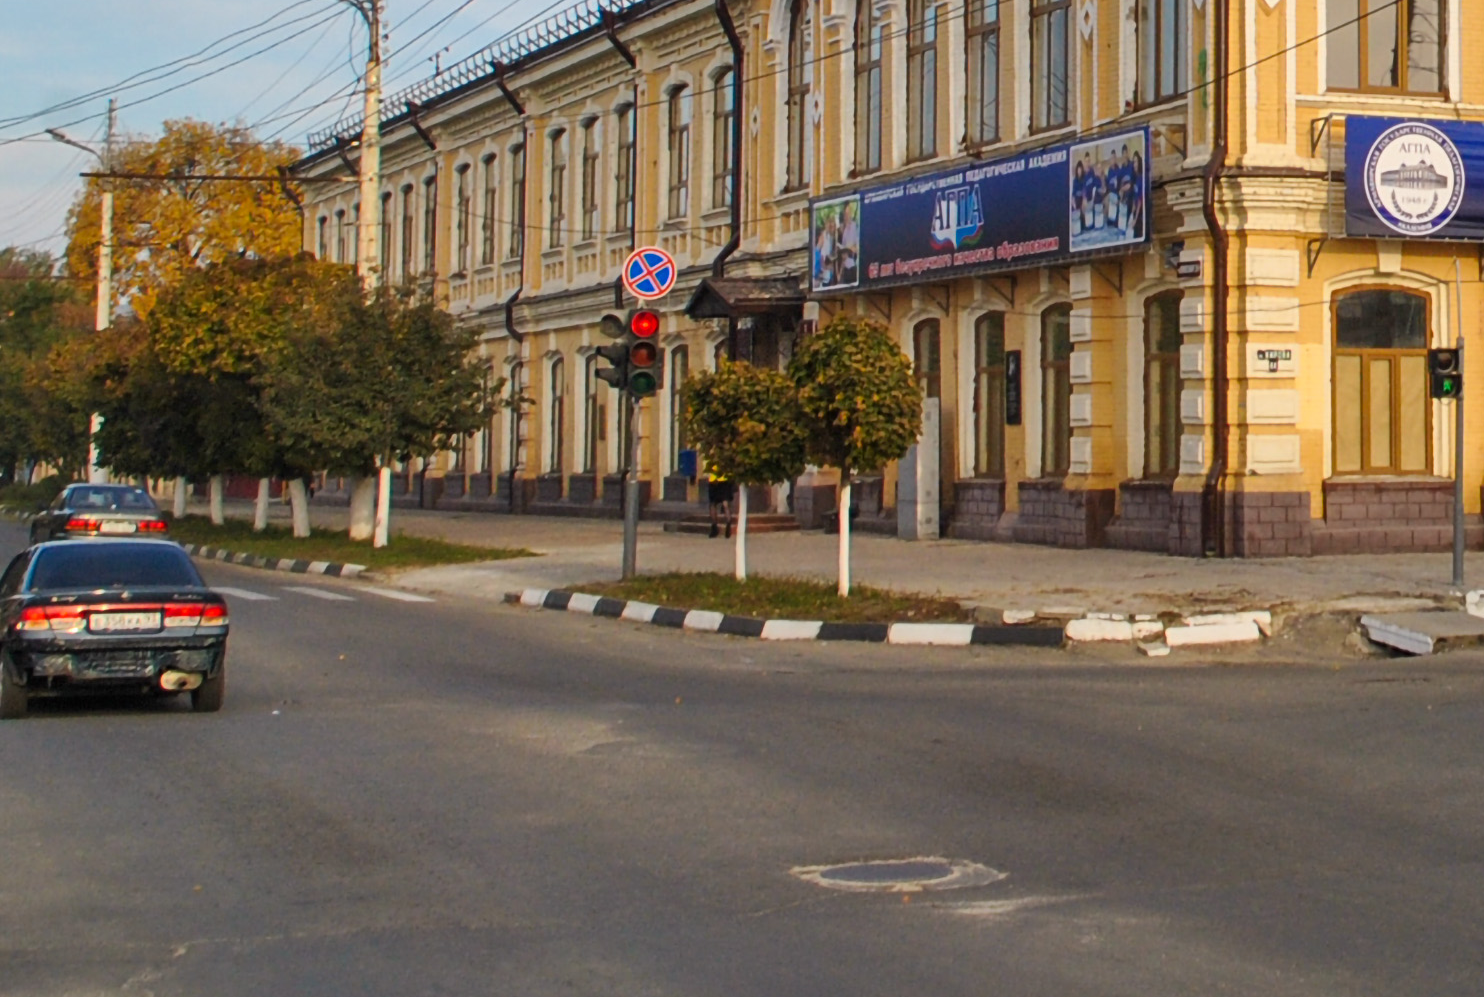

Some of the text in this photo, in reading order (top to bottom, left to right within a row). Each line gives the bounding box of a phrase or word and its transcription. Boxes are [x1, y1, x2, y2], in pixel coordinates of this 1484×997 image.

[1399, 142, 1431, 154] АГПА
[965, 159, 1025, 182] ПЕДАГОГИЧЕСКАЯ
[1028, 150, 1067, 168] АКАДЕМИЯ
[931, 183, 985, 232] АГПА
[997, 236, 1059, 261] образования
